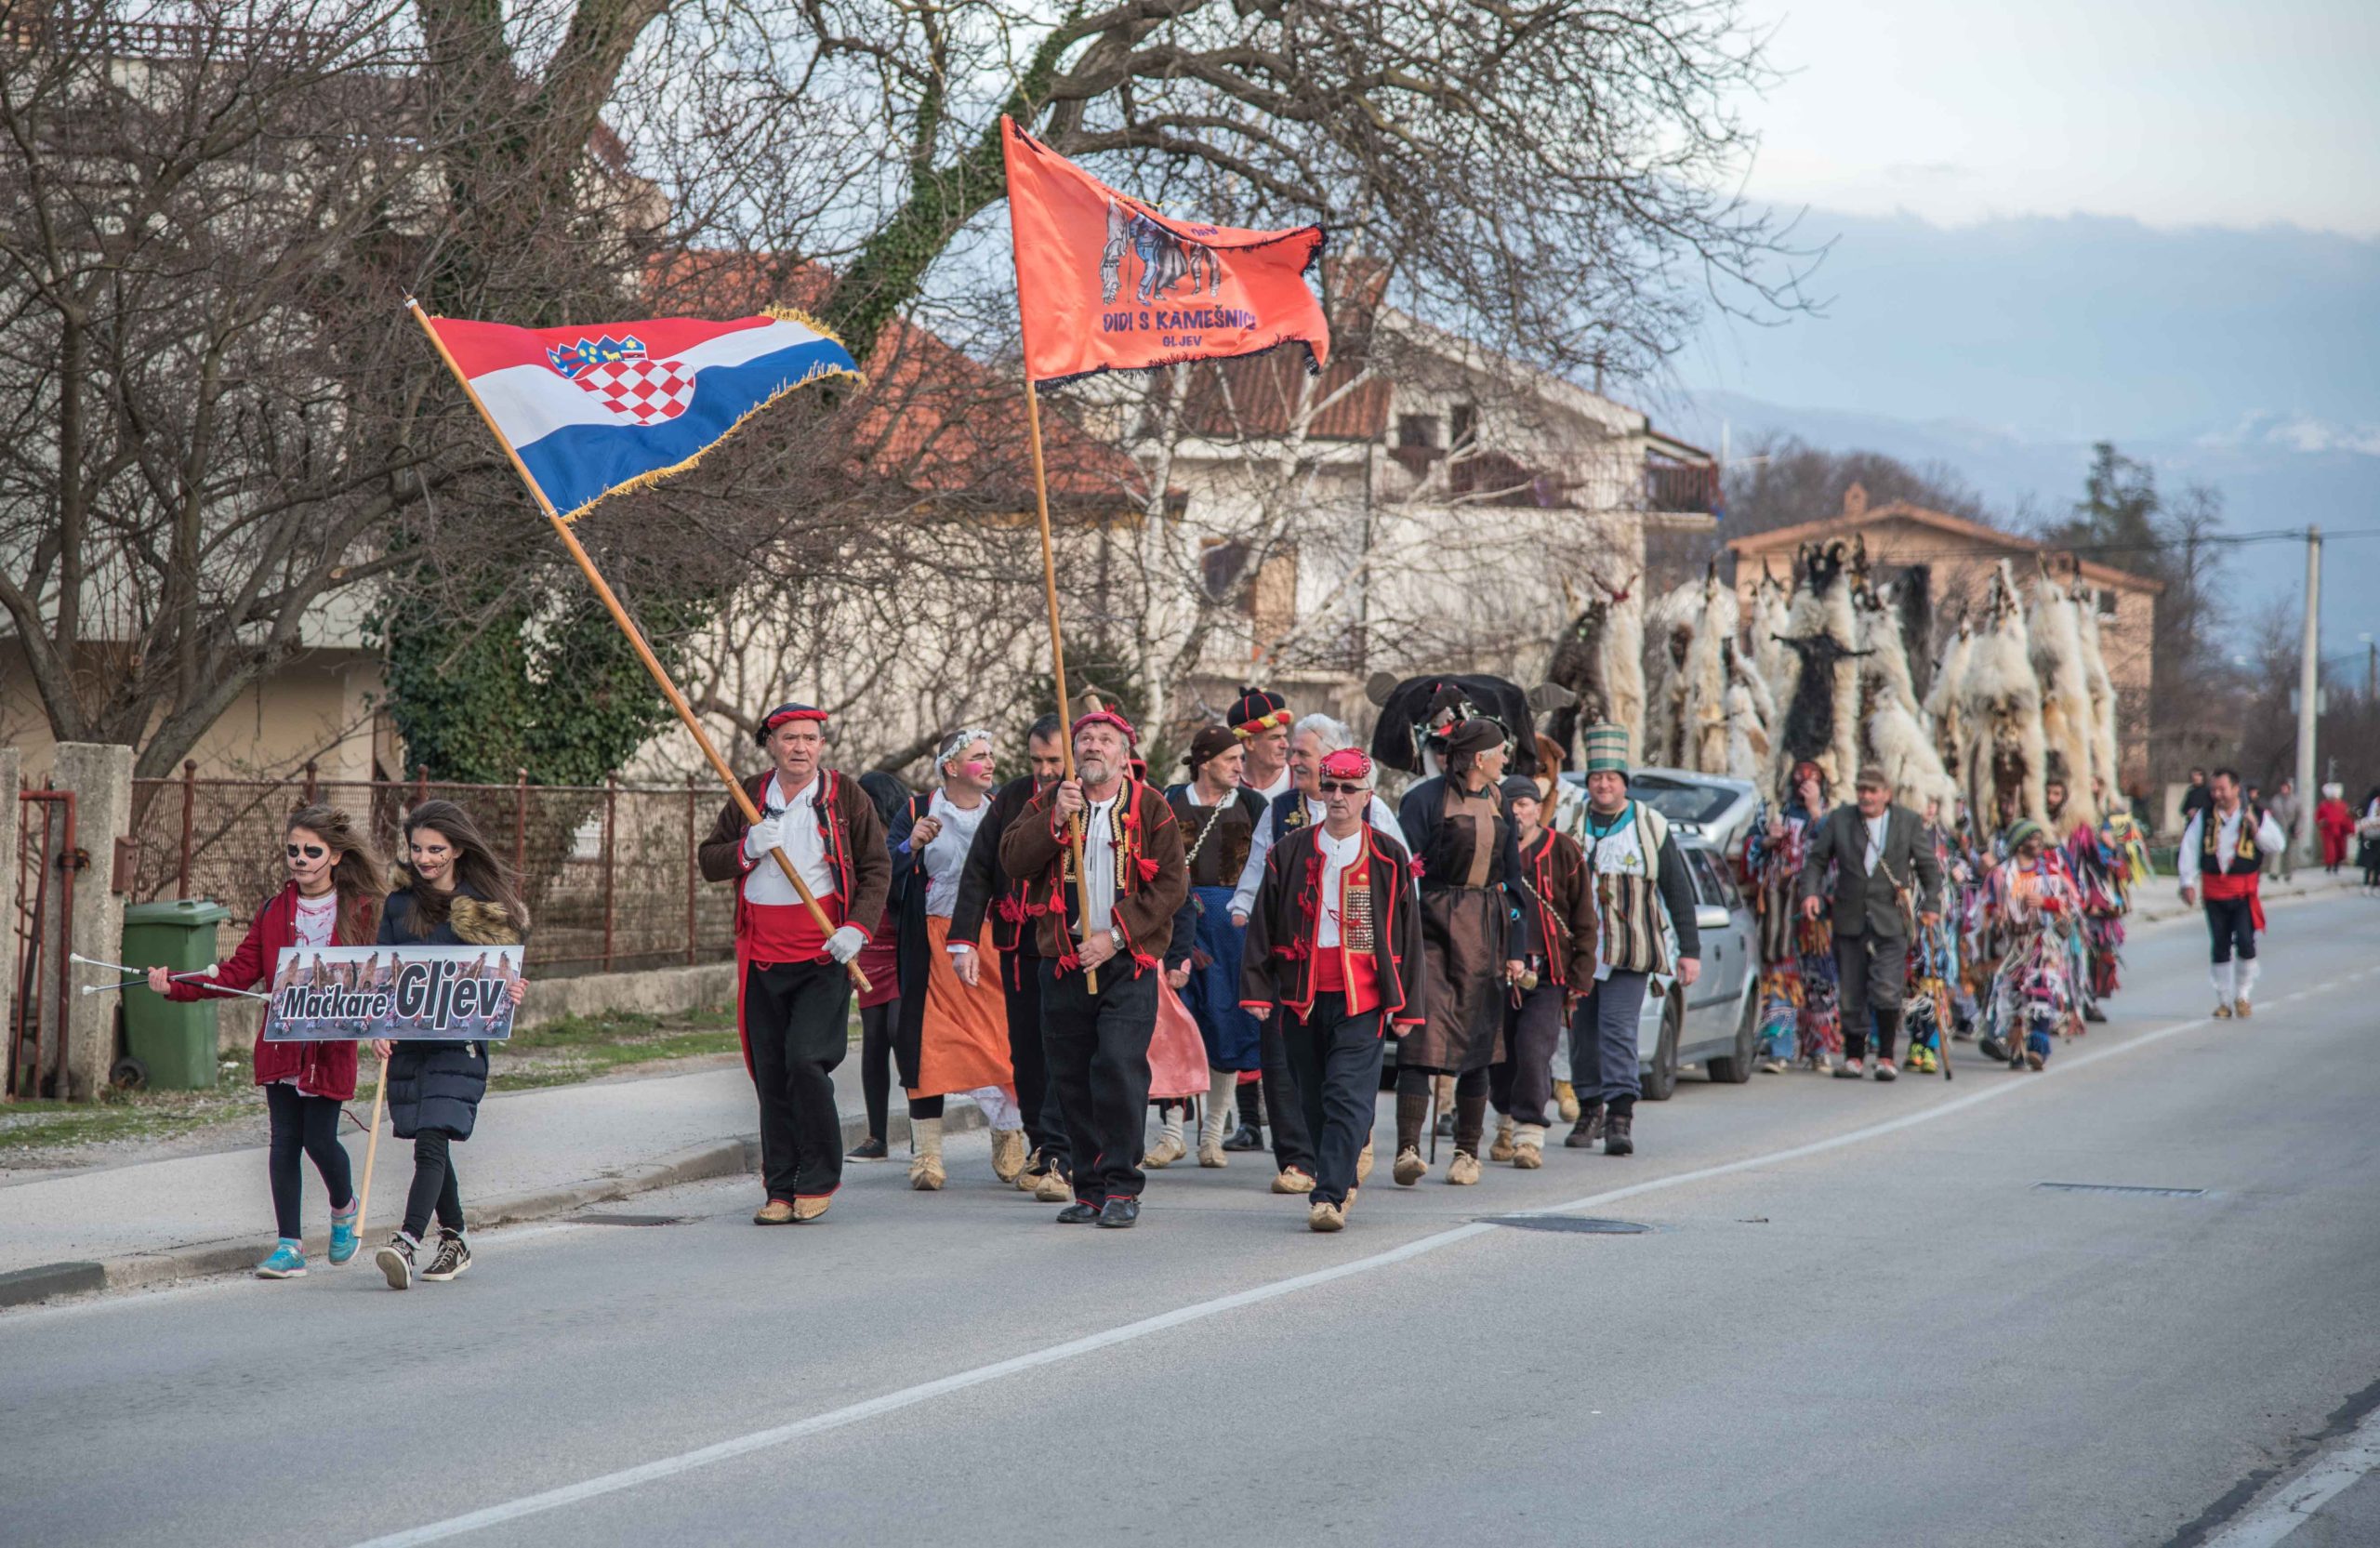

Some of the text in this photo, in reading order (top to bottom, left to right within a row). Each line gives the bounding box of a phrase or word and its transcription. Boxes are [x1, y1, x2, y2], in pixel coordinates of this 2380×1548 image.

[1103, 312, 1132, 332] DIDI
[1139, 311, 1149, 331] S
[1163, 336, 1202, 347] GLJEV
[280, 960, 507, 1031] Mačkare Gljev
